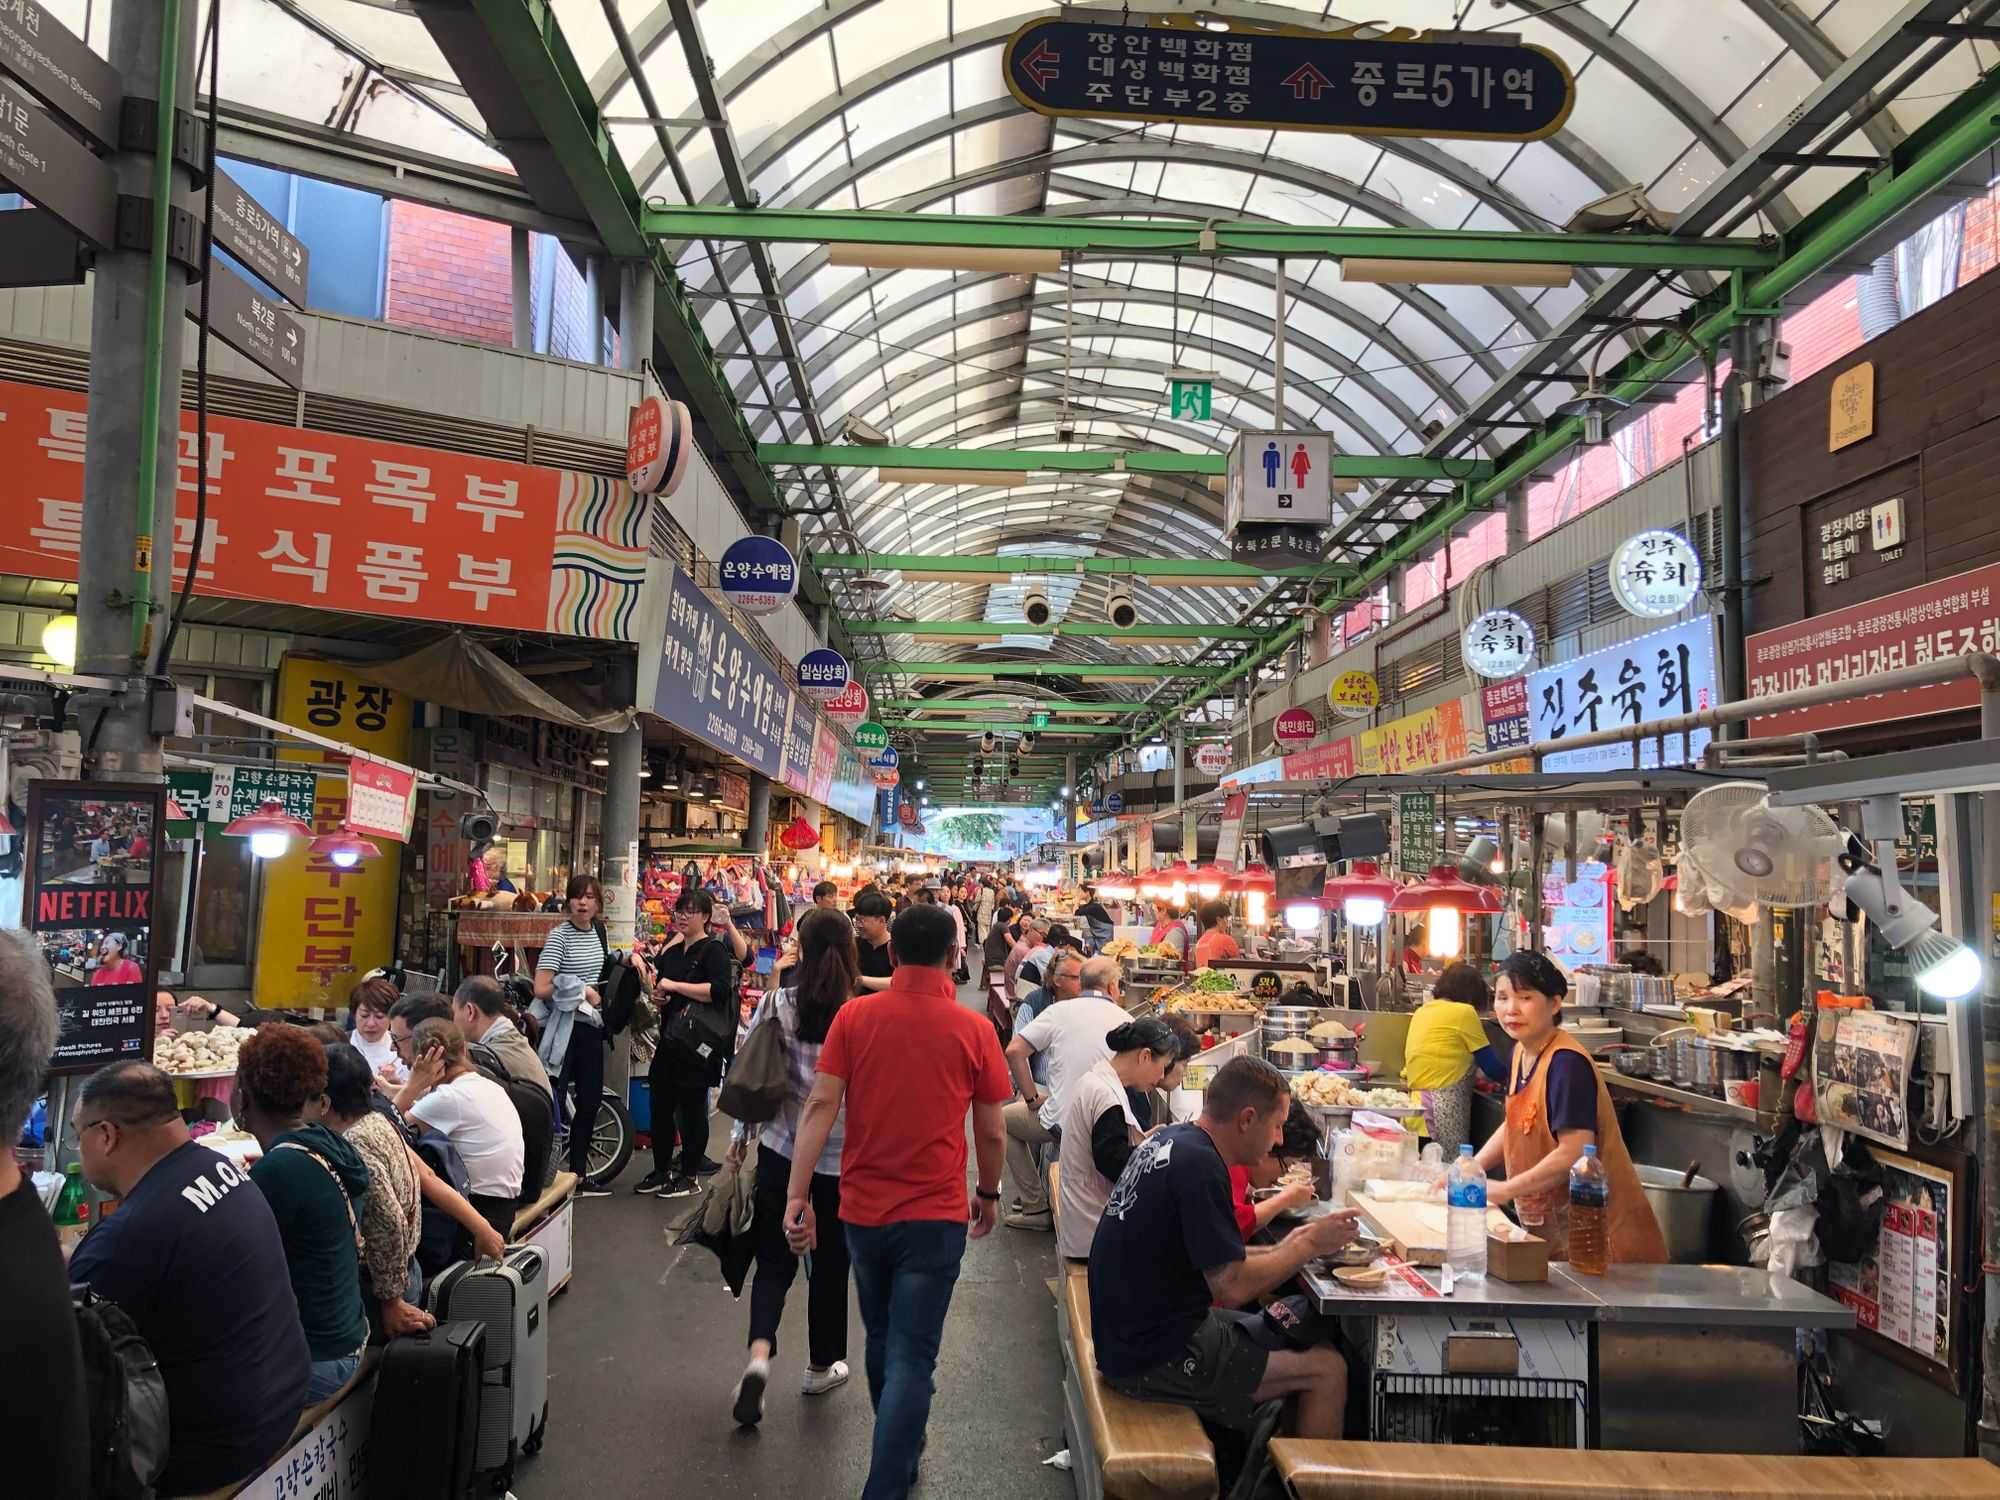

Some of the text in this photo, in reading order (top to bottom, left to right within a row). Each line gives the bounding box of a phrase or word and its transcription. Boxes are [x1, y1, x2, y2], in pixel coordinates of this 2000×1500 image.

[70, 77, 102, 112] Stream
[1351, 61, 1534, 110] 종로5가역
[17, 143, 39, 168] Gate
[40, 160, 47, 173] 1
[235, 194, 280, 248] 종로5가역
[252, 297, 276, 332] 북2문
[1820, 508, 1869, 543] 광장시장
[1639, 537, 1678, 556] 진주
[1821, 534, 1858, 562] 나들이
[1880, 548, 1903, 562] TOILET
[722, 561, 791, 581] 온양수예점
[1628, 560, 1687, 587] 육회
[1823, 559, 1848, 585] 쉼터
[1970, 586, 1991, 606] 부설
[1484, 617, 1516, 634] 진주
[1475, 634, 1525, 655] 육회
[711, 630, 774, 736] 온양수예점
[800, 664, 846, 682] 일심상회
[1539, 642, 1693, 740] 진주육회
[306, 678, 394, 733] 광장
[214, 784, 231, 797] 70
[237, 770, 263, 784] 고향
[215, 799, 225, 809] 호
[38, 889, 151, 924] NETFLIX
